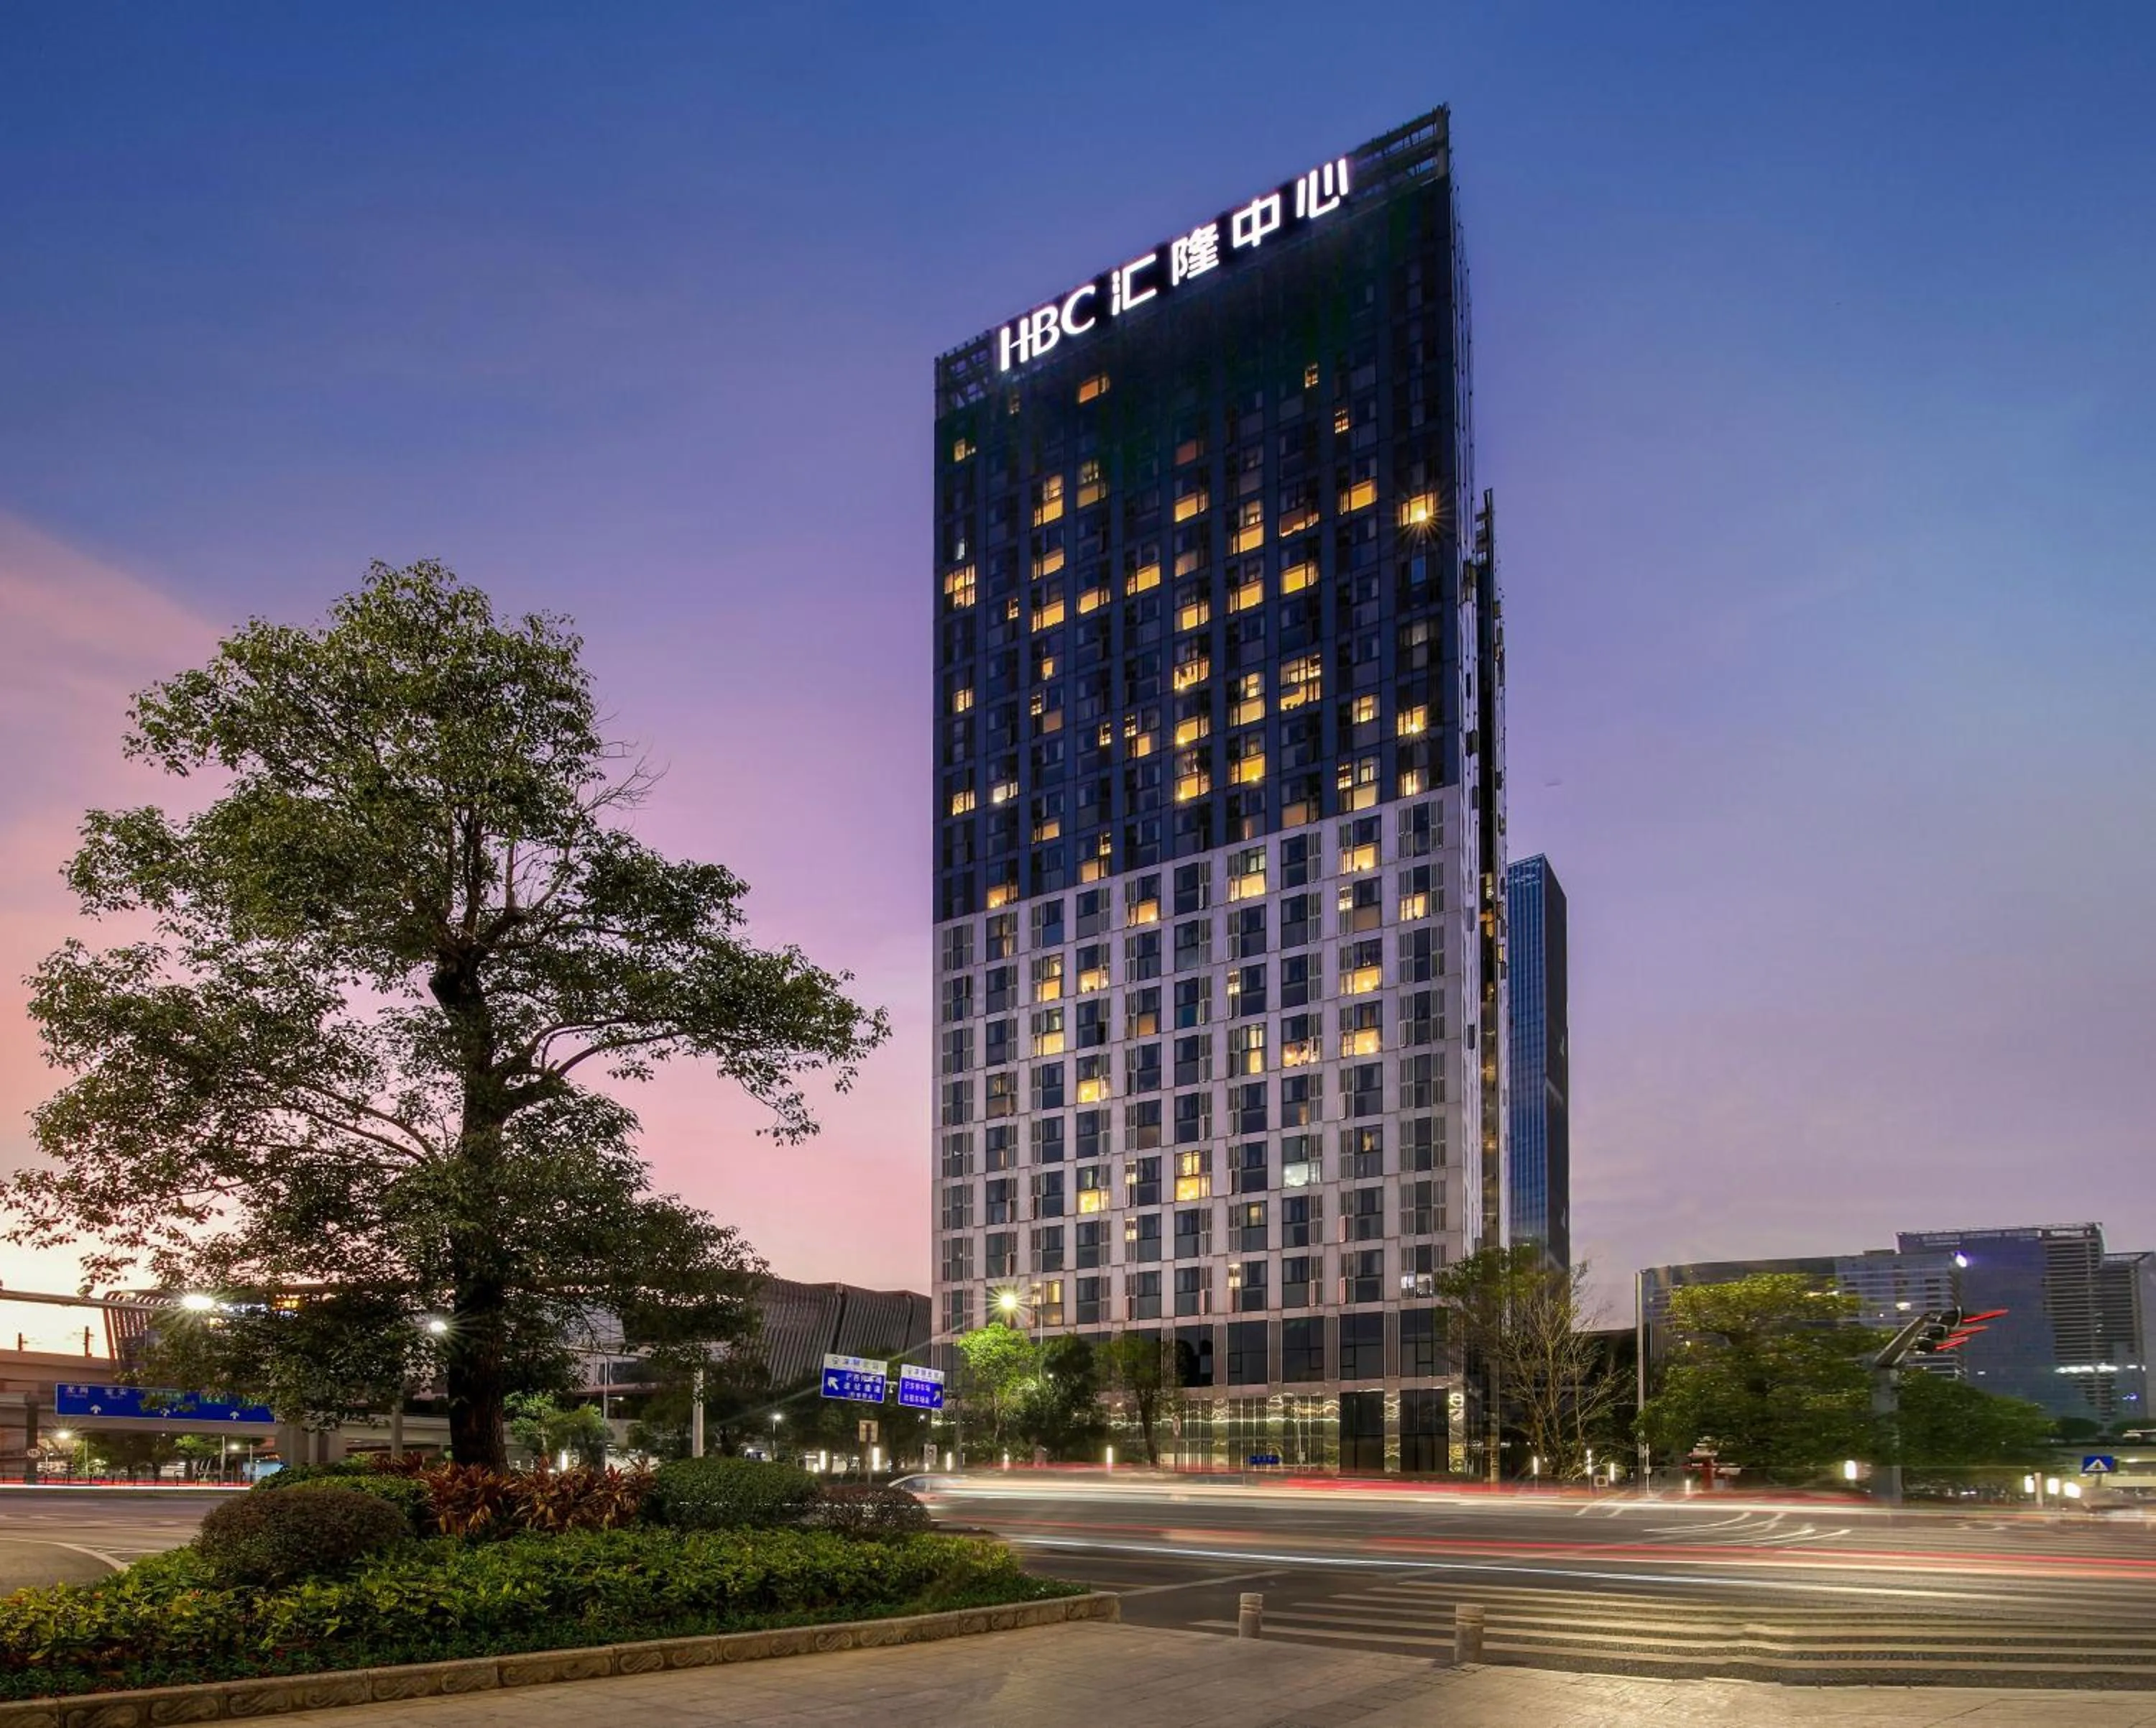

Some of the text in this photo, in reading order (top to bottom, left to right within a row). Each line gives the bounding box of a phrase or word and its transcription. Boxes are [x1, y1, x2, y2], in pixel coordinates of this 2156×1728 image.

[1000, 157, 1349, 372] HBC 汇隆中心
